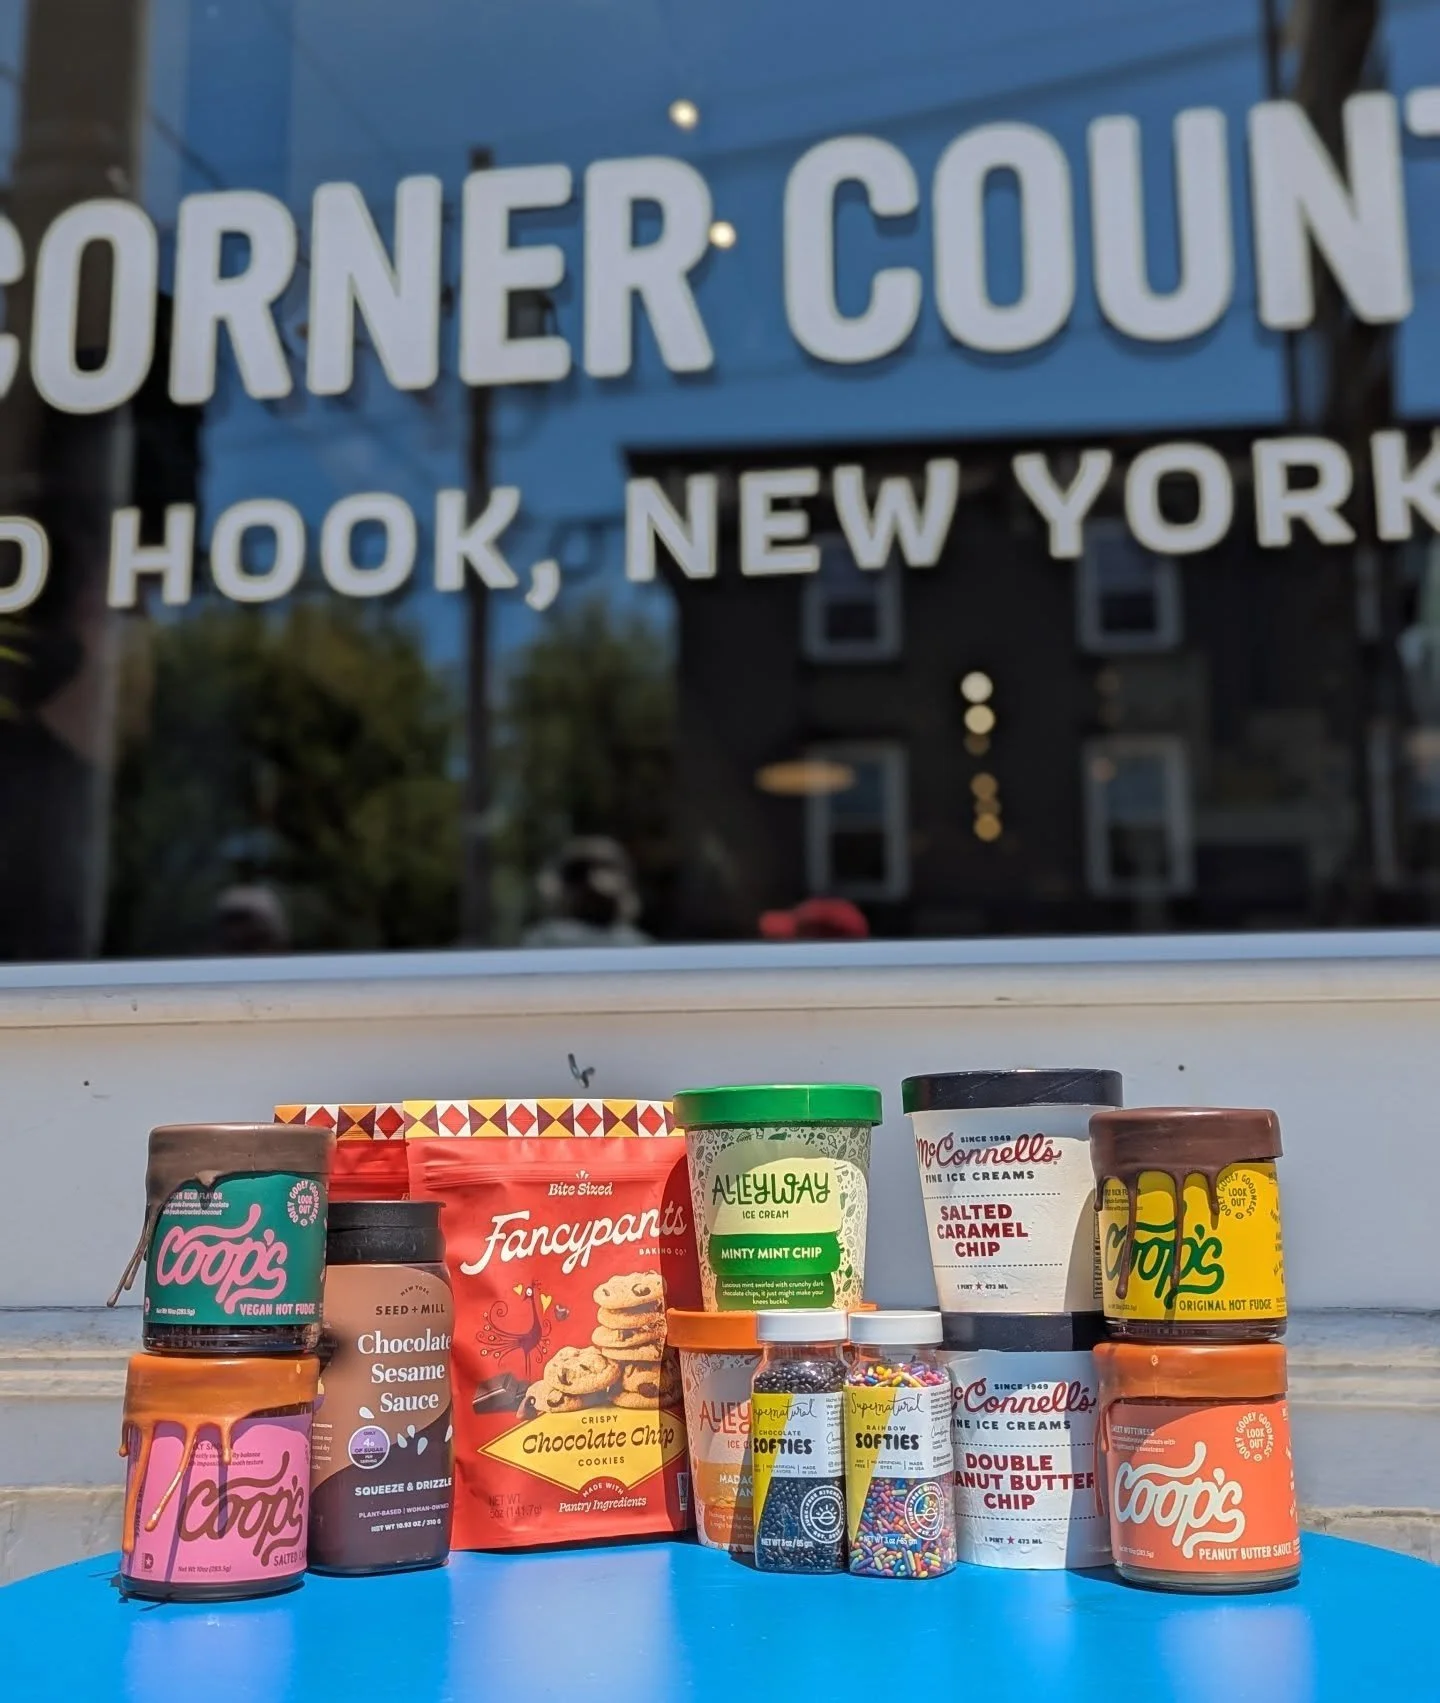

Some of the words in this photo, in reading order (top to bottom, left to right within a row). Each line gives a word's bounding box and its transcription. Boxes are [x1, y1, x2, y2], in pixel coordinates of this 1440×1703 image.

[0, 156, 714, 415] ORNER
[107, 487, 561, 612] HOOK,
[625, 458, 959, 582] NEW
[1011, 430, 1440, 560] YORK
[960, 1135, 987, 1143] SINCE
[925, 1174, 942, 1183] FINE
[947, 1173, 965, 1182] ICE
[972, 1170, 1035, 1181] CREAMS
[1218, 1172, 1239, 1192] GOOEY
[548, 1181, 575, 1197] Bite
[577, 1181, 613, 1196] Sized
[712, 1172, 831, 1206] ALLEYWAY
[1228, 1187, 1248, 1197] LOOK
[1241, 1174, 1257, 1217] GOODNESS
[297, 1195, 312, 1205] LOOK
[1231, 1198, 1246, 1207] OUT
[299, 1205, 311, 1214] OUT
[742, 1210, 756, 1220] ICE
[758, 1210, 789, 1219] CREAM
[940, 1203, 1013, 1221] SALTED
[460, 1200, 687, 1276] Fancypants
[936, 1222, 1029, 1239] CARAMEL
[639, 1248, 672, 1256] BAKING
[721, 1248, 756, 1260] MINTY
[757, 1247, 789, 1259] MINT
[791, 1247, 823, 1259] CHIP
[955, 1241, 1001, 1258] CHIP
[156, 1203, 288, 1314] Coop's
[400, 1285, 414, 1297] NEW
[415, 1284, 430, 1295] YORK
[766, 1290, 777, 1298] just
[240, 1303, 273, 1316] VEGAN
[275, 1303, 294, 1315] HOT
[295, 1302, 315, 1315] FUDGE
[375, 1305, 409, 1316] SEED
[420, 1304, 445, 1315] MILL
[1179, 1299, 1227, 1312] ORIGINAL
[1229, 1299, 1248, 1311] HOT
[1249, 1298, 1272, 1310] FUDGE
[357, 1328, 452, 1354] Chocolate
[371, 1363, 445, 1383] Sesame
[379, 1392, 439, 1413] Sauce
[950, 1377, 1097, 1415] cConnell's
[753, 1397, 818, 1424] upernatural
[851, 1392, 925, 1418] Supernatural
[581, 1415, 618, 1425] CRISPY
[699, 1400, 752, 1435] ALLEY
[952, 1419, 971, 1429] INE
[976, 1420, 999, 1430] ICE
[1006, 1420, 1071, 1431] CREAMS
[1236, 1411, 1257, 1434] GOOEY
[522, 1429, 627, 1454] Chocolate
[630, 1425, 675, 1449] Chip
[855, 1432, 920, 1450] SOFTIES
[1246, 1427, 1265, 1438] LOOK
[1258, 1412, 1274, 1458] GOODNESS
[727, 1440, 740, 1448] ICE
[753, 1438, 813, 1455] SOFTIES
[1249, 1438, 1264, 1449] OUT
[578, 1456, 625, 1467] COOKIES
[965, 1452, 1053, 1471] DOUBLE
[354, 1483, 405, 1496] SQUEEZE
[406, 1481, 414, 1492] &
[416, 1477, 452, 1491] DRIZZLE
[582, 1483, 603, 1498] MADE
[605, 1482, 624, 1495] WITH
[954, 1472, 1004, 1490] ANUT
[1010, 1472, 1095, 1491] BUTTER
[178, 1450, 305, 1567] Coop's
[489, 1494, 506, 1507] NET
[558, 1498, 592, 1513] Pantry
[592, 1496, 647, 1511] Ingredients
[983, 1492, 1035, 1510] CHIP
[1114, 1441, 1246, 1559] Coop's
[358, 1508, 402, 1519] PLANT-BASED
[371, 1525, 384, 1533] NET
[385, 1523, 396, 1531] WT
[989, 1536, 1004, 1544] PINT
[273, 1553, 298, 1567] SALTED
[1199, 1548, 1239, 1561] PEANUT
[1240, 1545, 1271, 1560] BUTTER
[1273, 1542, 1292, 1557] SAUCE
